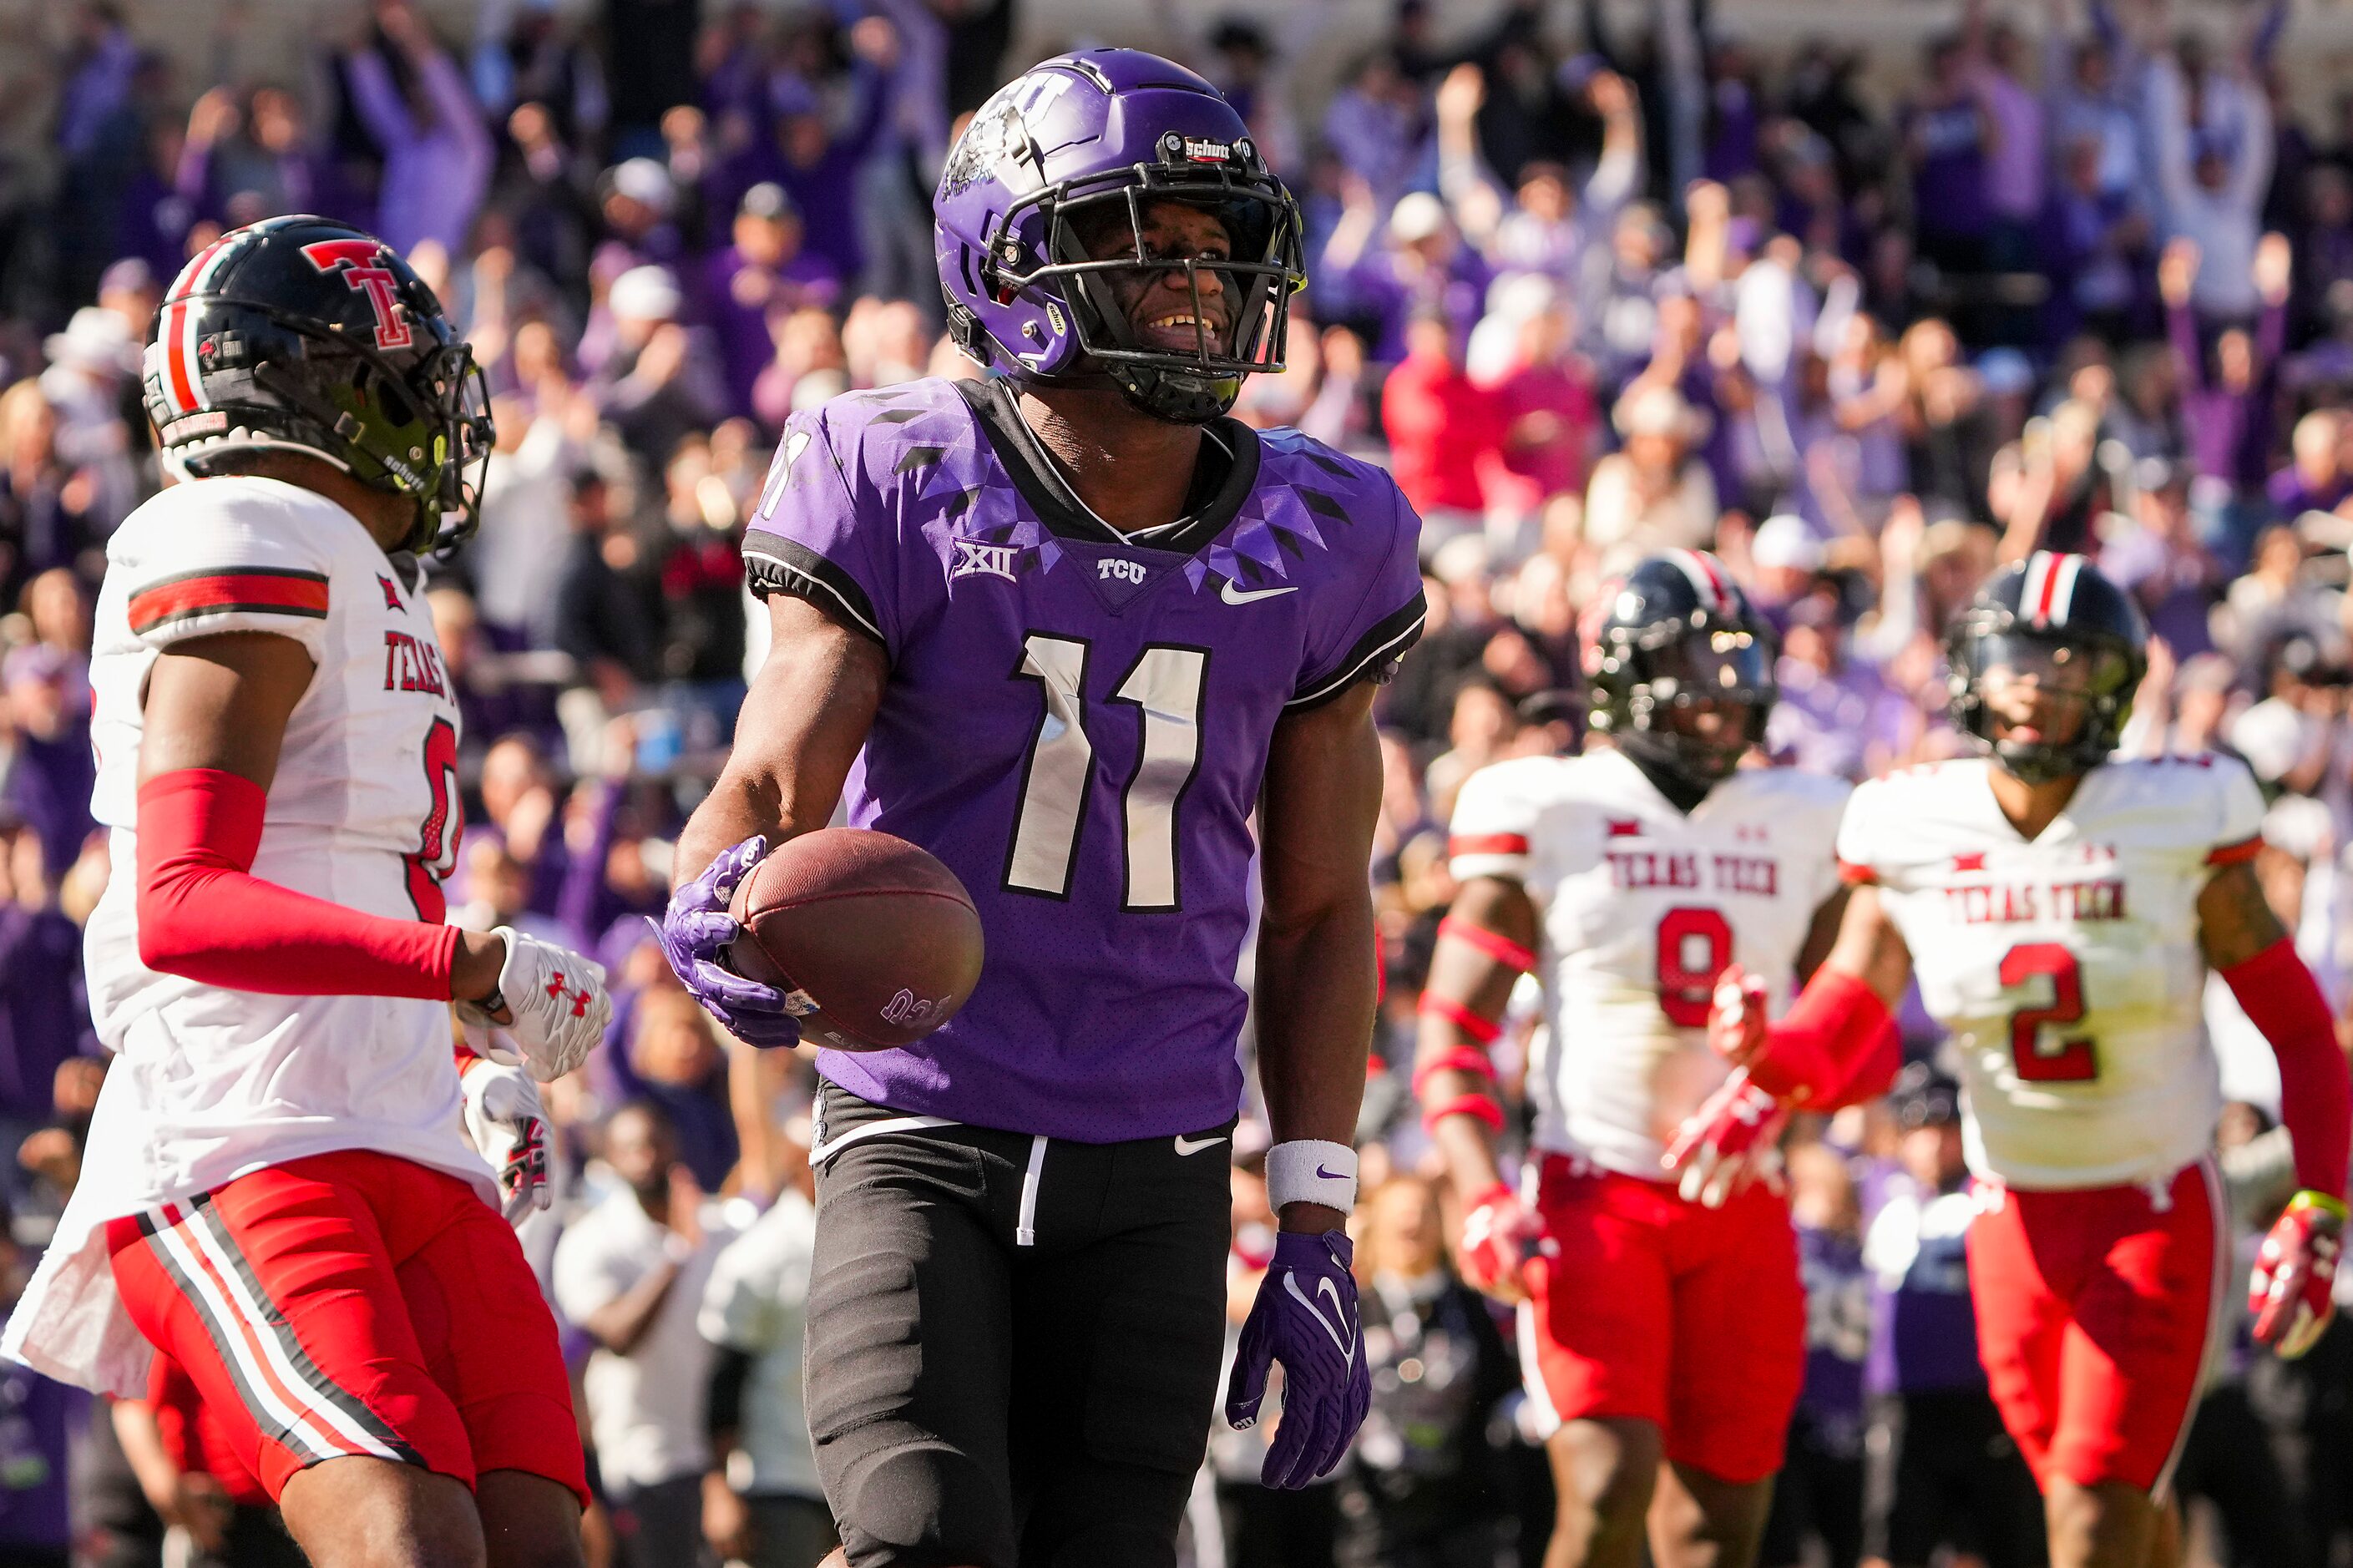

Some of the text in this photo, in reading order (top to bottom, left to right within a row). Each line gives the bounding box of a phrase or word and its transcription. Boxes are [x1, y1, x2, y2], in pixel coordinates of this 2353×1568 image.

[1186, 139, 1230, 159] schutt
[1049, 305, 1064, 331] schutt
[1097, 558, 1146, 584] TCU
[1000, 628, 1212, 913] 11
[1607, 851, 1778, 896] TEXAS TECH
[1944, 878, 2125, 923] TEXAS TECH
[1998, 941, 2098, 1081] 2
